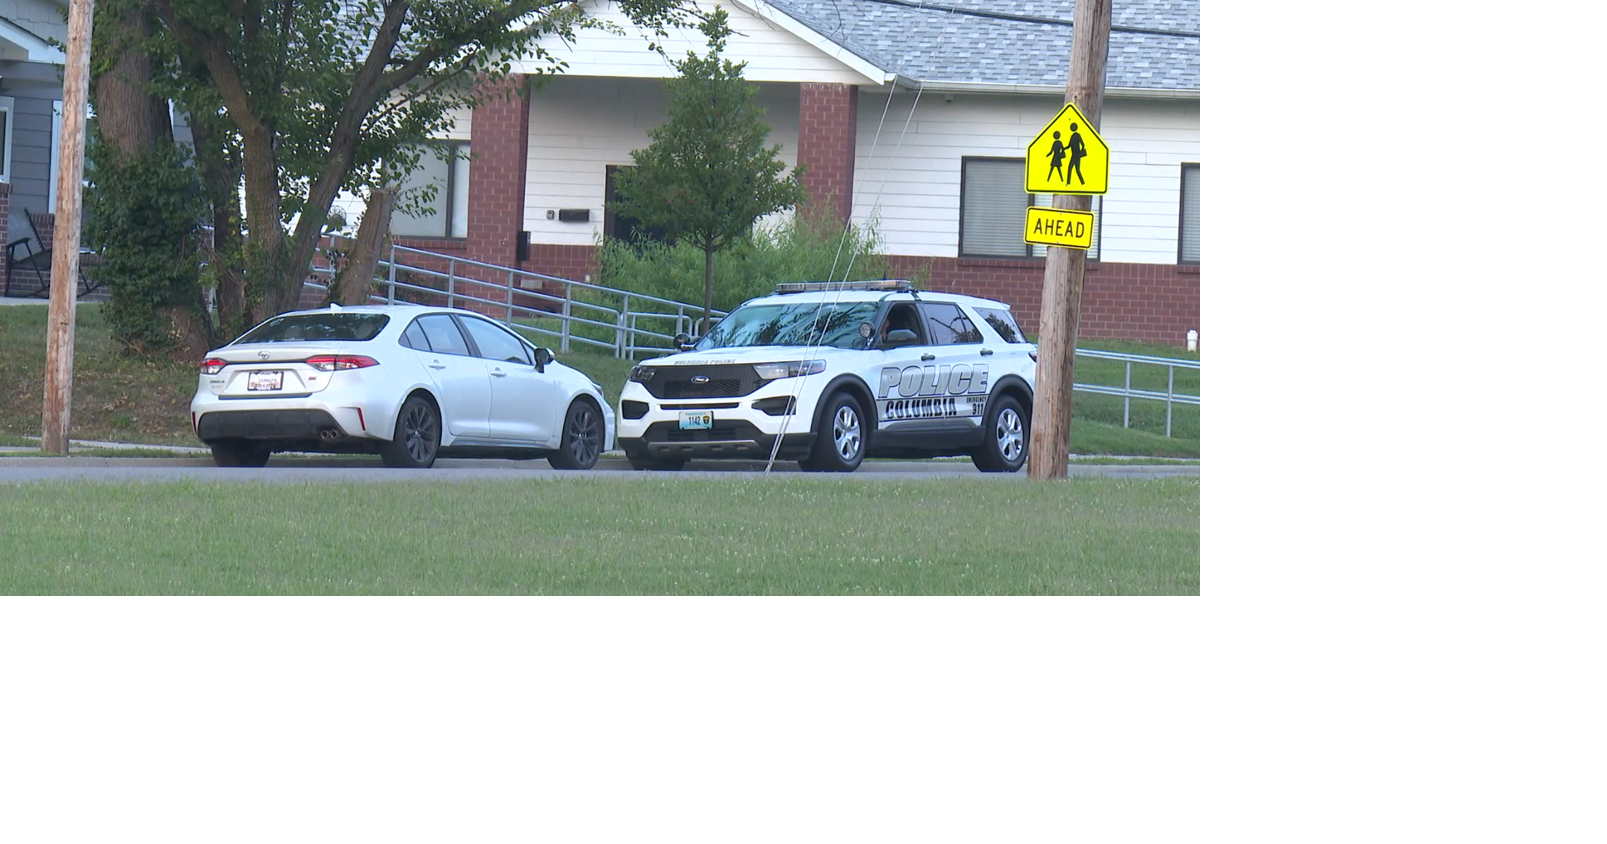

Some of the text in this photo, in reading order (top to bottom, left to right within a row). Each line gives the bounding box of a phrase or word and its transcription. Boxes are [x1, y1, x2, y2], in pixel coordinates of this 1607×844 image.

[1033, 217, 1085, 238] AHEAD
[878, 363, 989, 398] POLICE
[886, 398, 957, 419] COLUMBIA
[972, 403, 984, 415] 911
[688, 415, 701, 425] 1142
